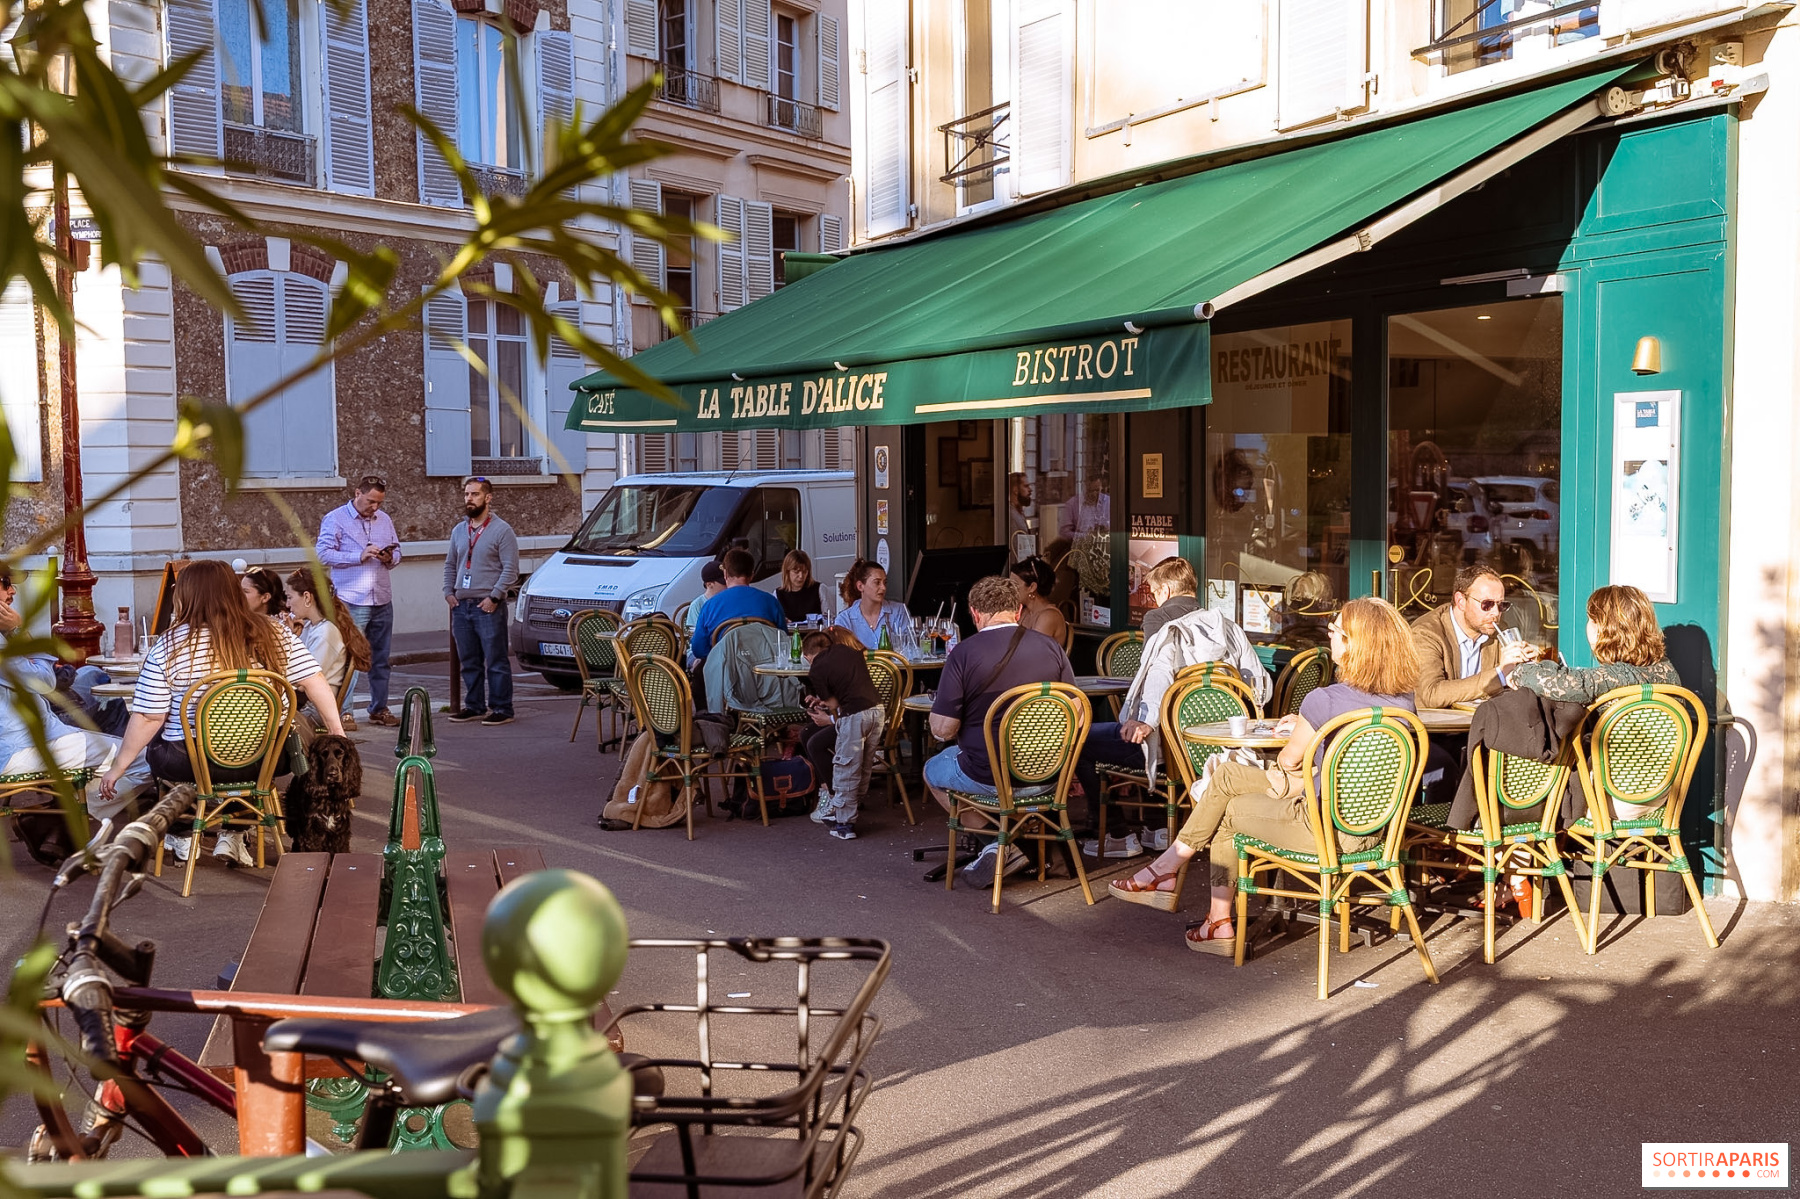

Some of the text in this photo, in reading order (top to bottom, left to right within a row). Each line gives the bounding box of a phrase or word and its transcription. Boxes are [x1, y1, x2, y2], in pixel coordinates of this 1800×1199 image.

[70, 219, 91, 228] PLACE
[1012, 337, 1138, 386] BISTROT
[1217, 338, 1342, 383] RESTAURANT
[588, 388, 616, 415] CAFÉ
[697, 372, 888, 419] LA TABLE D'ALICE
[1131, 515, 1173, 526] LA TABLE
[1131, 526, 1165, 538] D'ALICE
